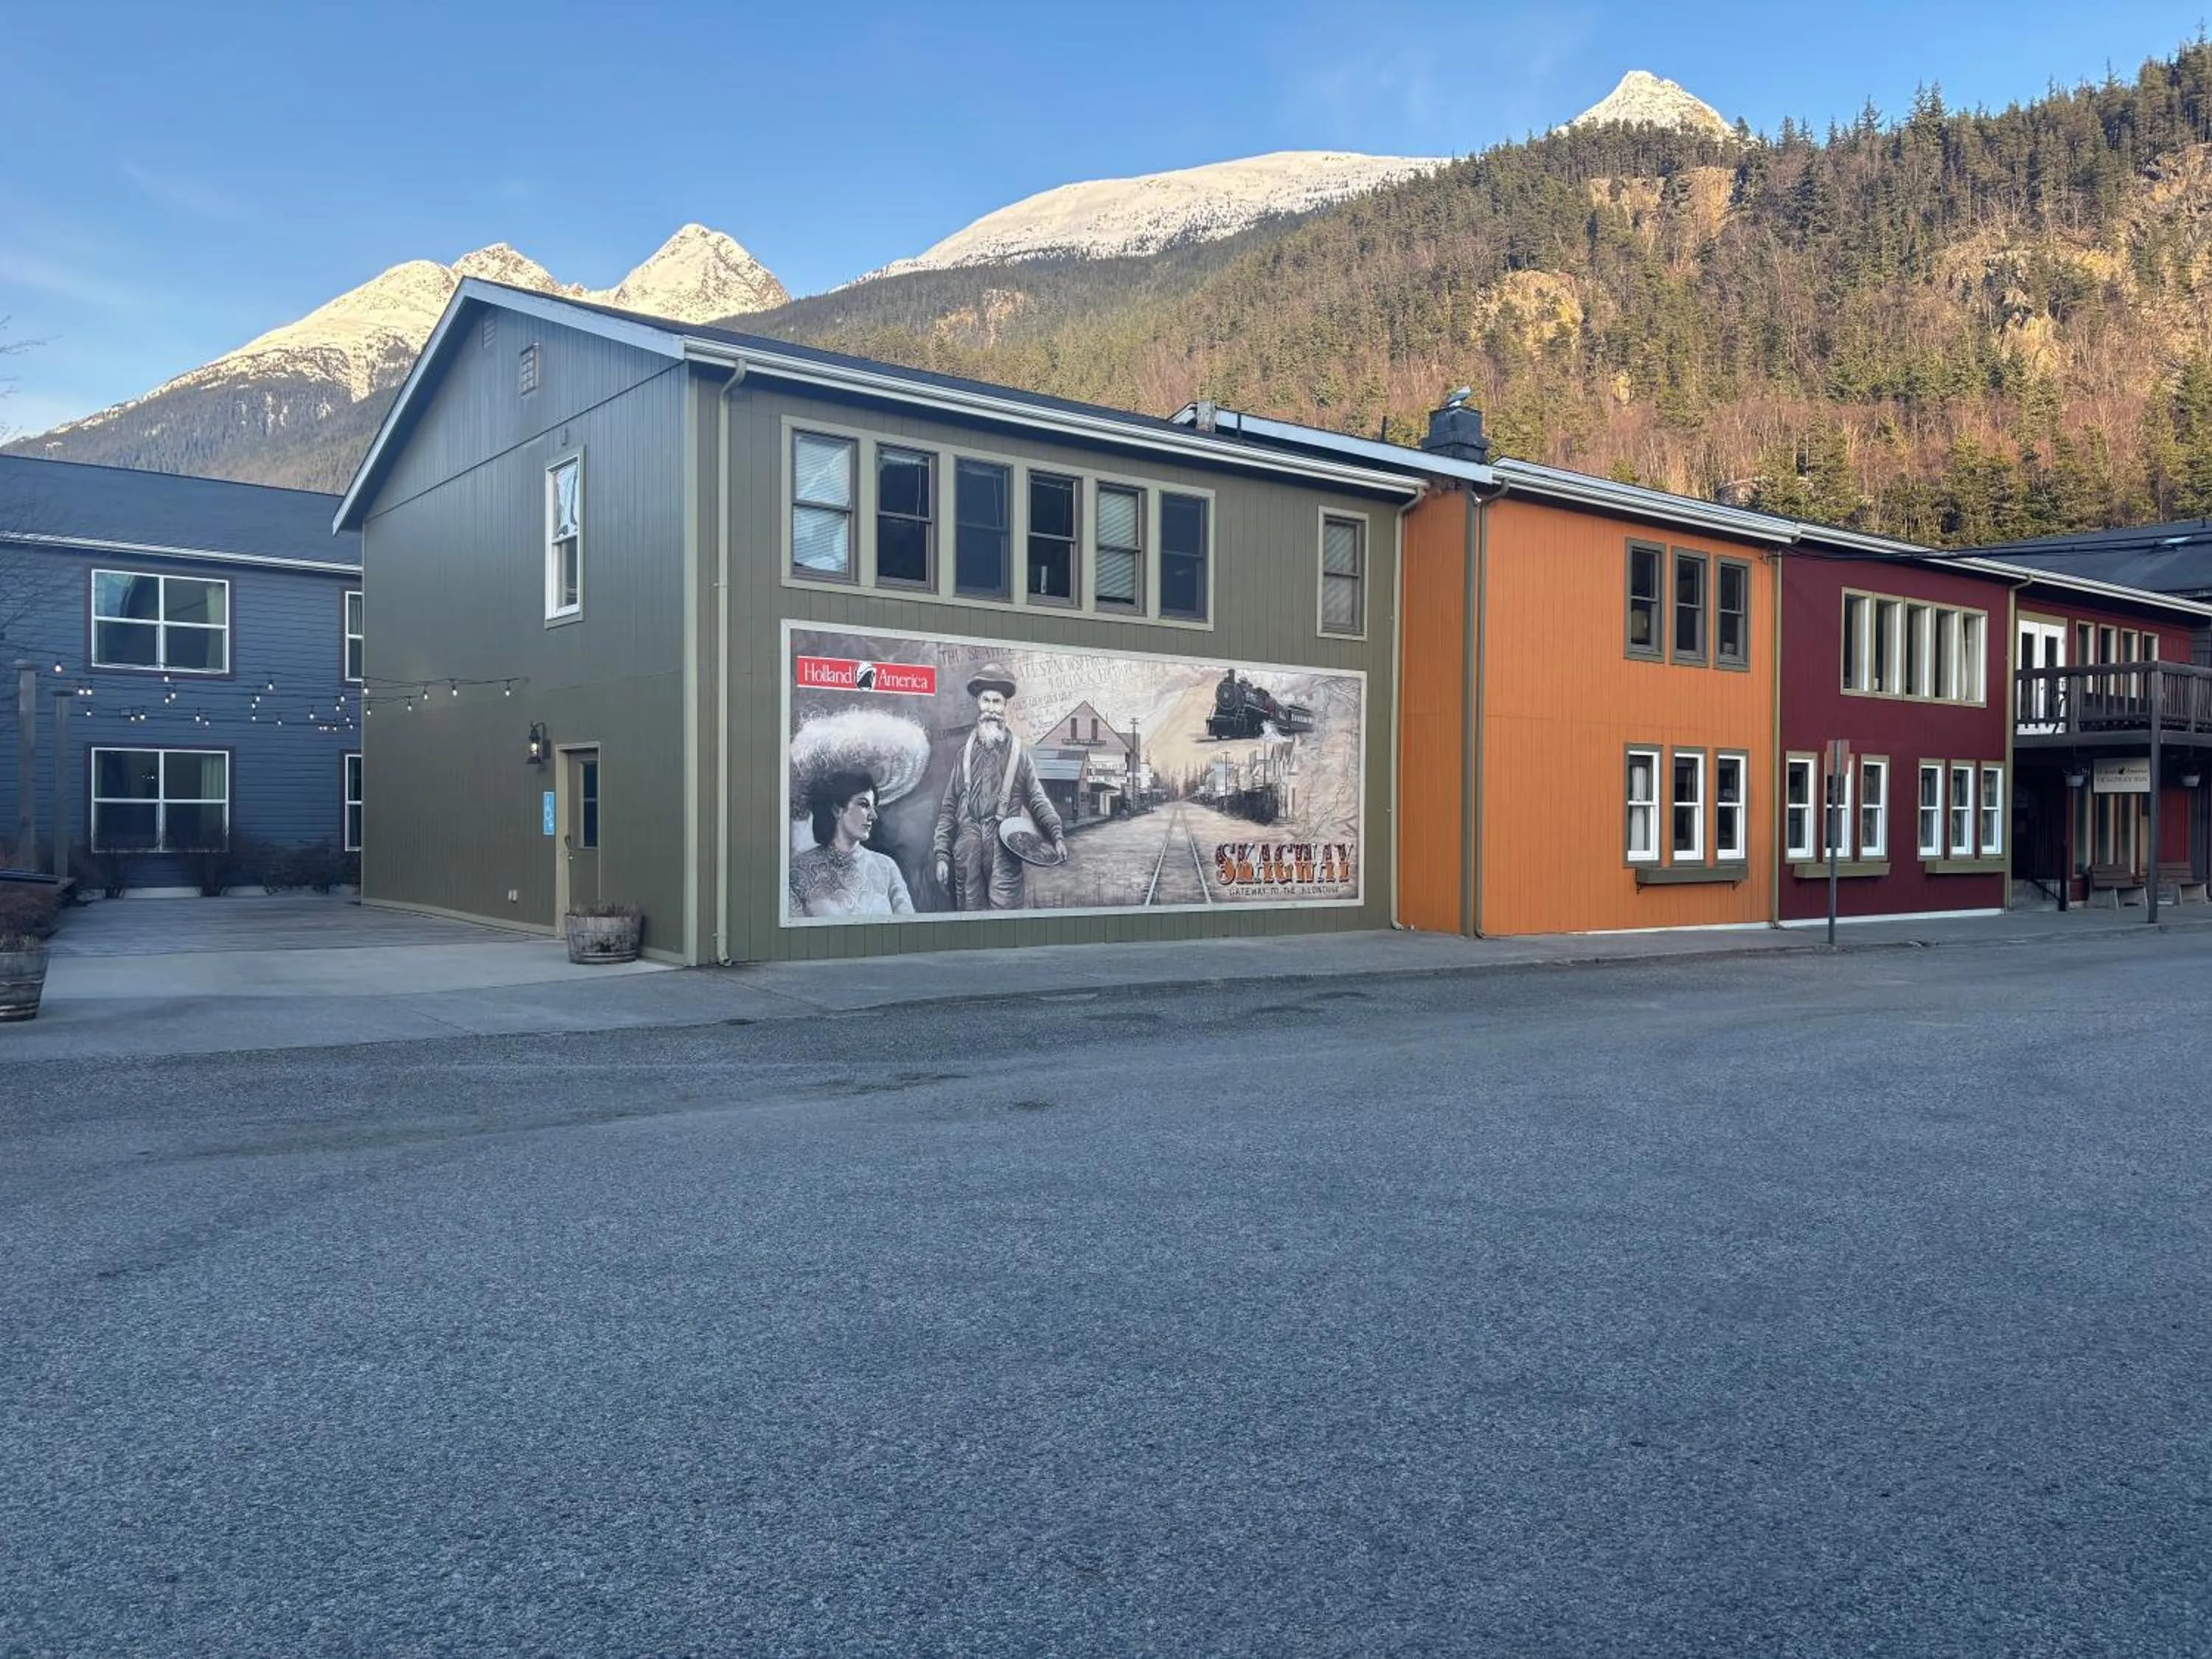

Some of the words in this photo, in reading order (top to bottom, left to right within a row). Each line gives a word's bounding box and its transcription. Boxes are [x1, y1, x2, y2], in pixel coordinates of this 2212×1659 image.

[804, 661, 852, 684] Holland
[878, 668, 928, 689] America
[1215, 843, 1354, 885] SKAGWAY
[1270, 887, 1279, 895] TO
